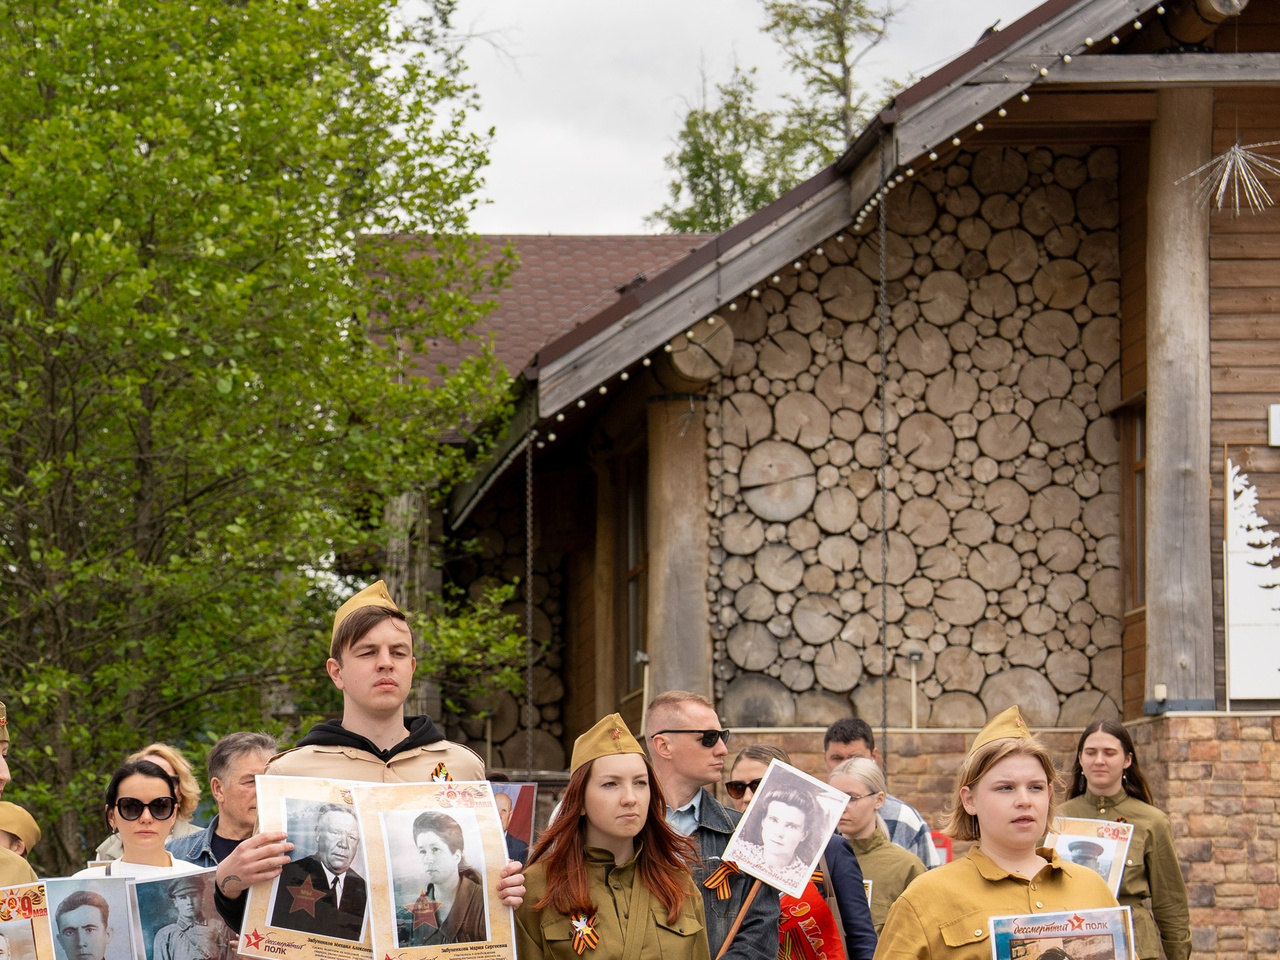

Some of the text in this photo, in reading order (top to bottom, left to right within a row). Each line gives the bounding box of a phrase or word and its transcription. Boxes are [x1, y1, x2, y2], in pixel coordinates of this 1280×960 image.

[21, 896, 32, 919] 9
[789, 902, 811, 917] 9
[264, 945, 287, 955] ПОЛК
